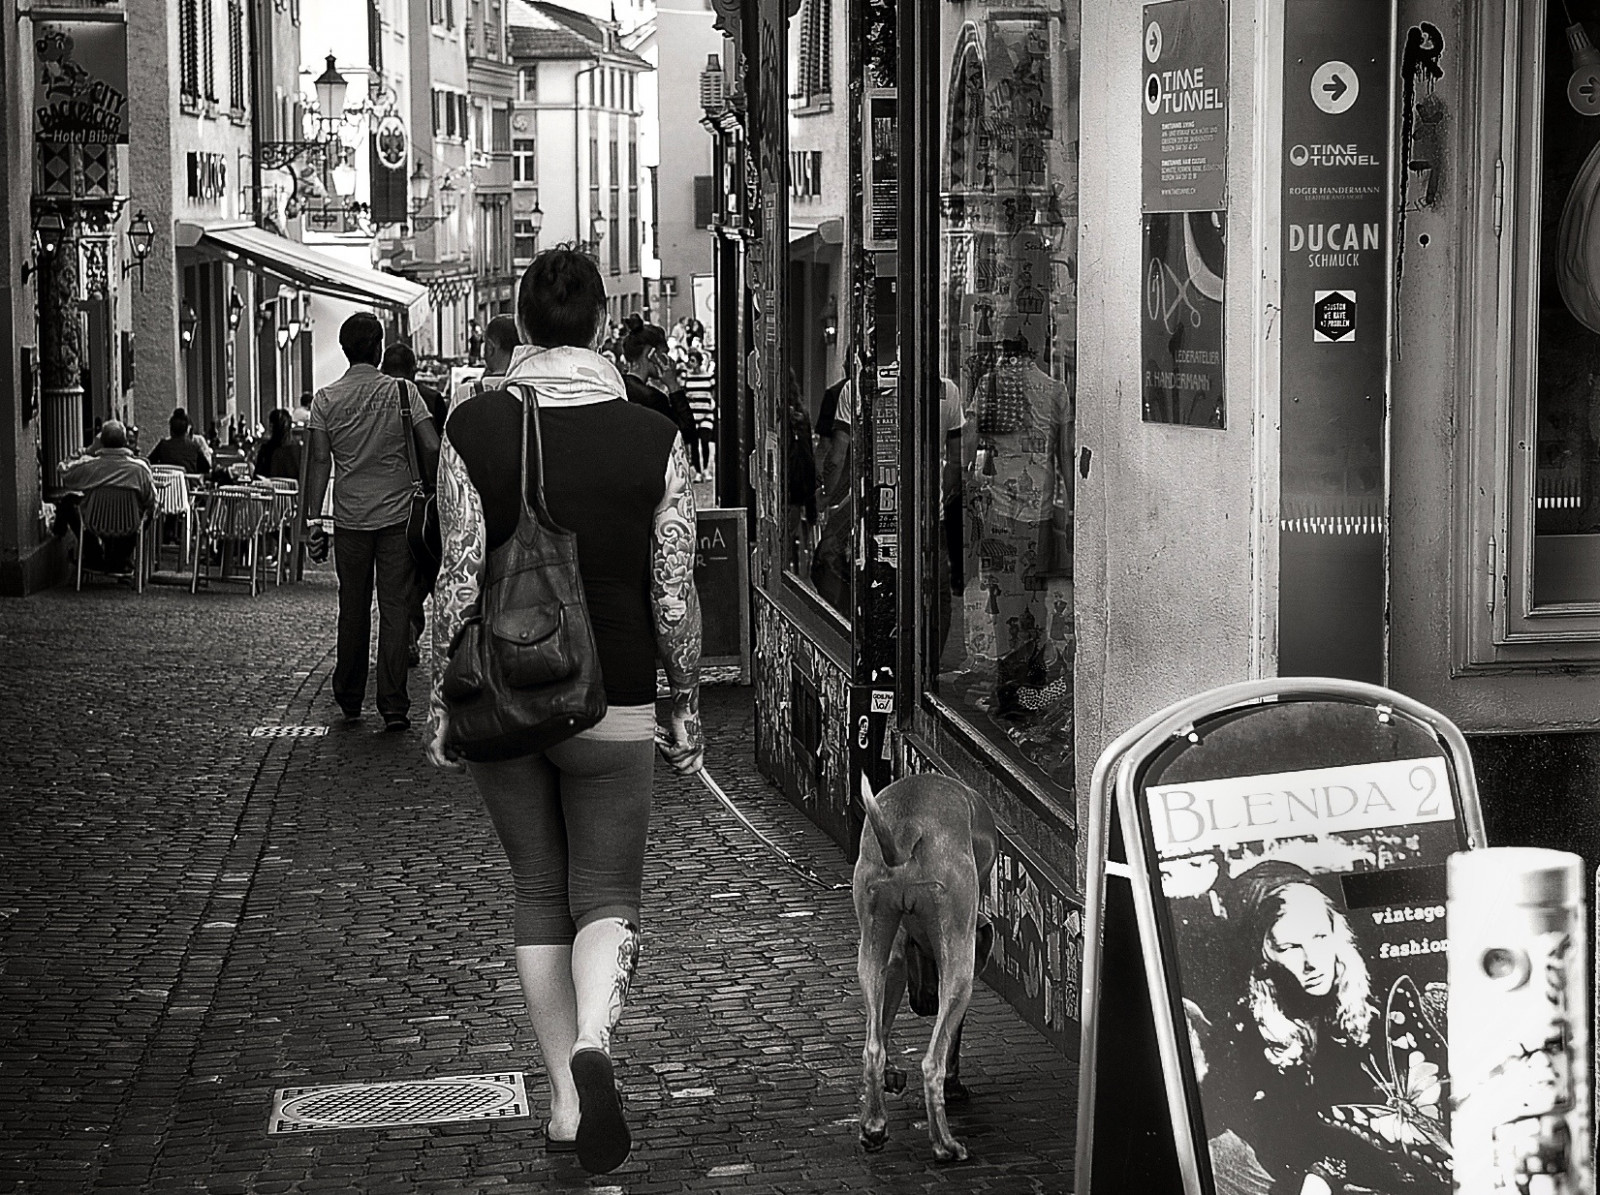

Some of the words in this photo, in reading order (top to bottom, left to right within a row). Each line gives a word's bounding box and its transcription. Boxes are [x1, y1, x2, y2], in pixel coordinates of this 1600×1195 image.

[1162, 67, 1204, 92] TIME
[90, 81, 128, 114] CITY
[1162, 88, 1224, 114] TUNNEL
[37, 100, 122, 134] BACKPACKER
[53, 129, 86, 143] Hotel
[88, 129, 120, 143] Biber
[1310, 144, 1358, 155] TIME
[1310, 155, 1380, 166] TUNNEL
[1289, 187, 1318, 195] ROGER
[1319, 186, 1380, 194] HANDERMANN
[1289, 223, 1379, 252] DUCAN
[1308, 253, 1360, 268] SCHMUCK
[1175, 350, 1220, 365] LEDERATELIER
[1158, 781, 1397, 845] BLENDA
[1408, 765, 1441, 818] 2
[1372, 904, 1446, 925] vintage
[1379, 938, 1449, 960] fashion
